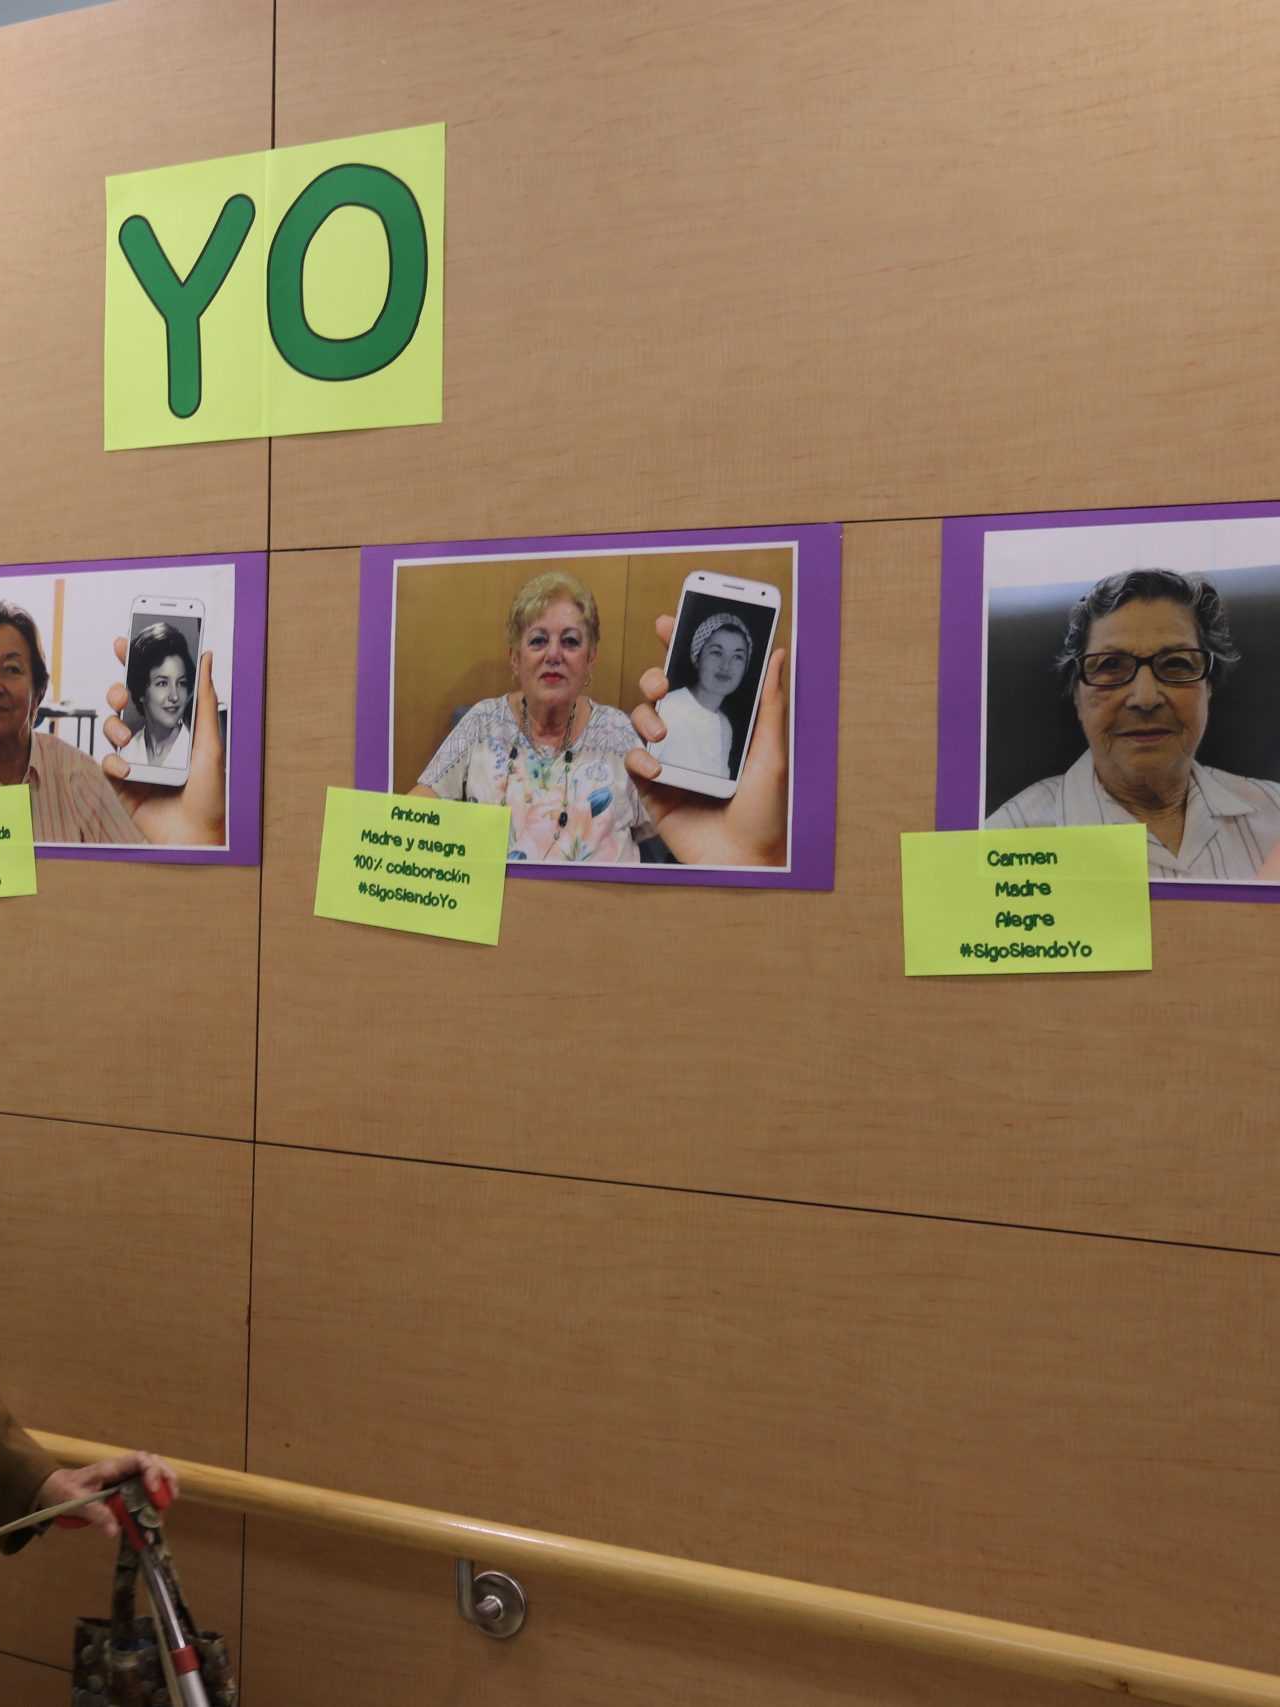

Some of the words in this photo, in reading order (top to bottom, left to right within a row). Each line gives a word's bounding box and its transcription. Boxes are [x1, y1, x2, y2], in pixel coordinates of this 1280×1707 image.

[118, 162, 428, 419] YO
[391, 806, 440, 826] Antonia
[361, 830, 402, 847] Madre
[405, 838, 414, 851] y
[418, 838, 466, 857] suegra
[354, 854, 382, 871] 100%
[386, 860, 470, 884] colaboración
[987, 850, 1058, 868] Carmen
[358, 881, 457, 910] #SigoSiendoYo
[995, 880, 1051, 897] Madre
[995, 911, 1055, 931] Alegre
[960, 941, 1092, 962] #SigoSiendoYo
